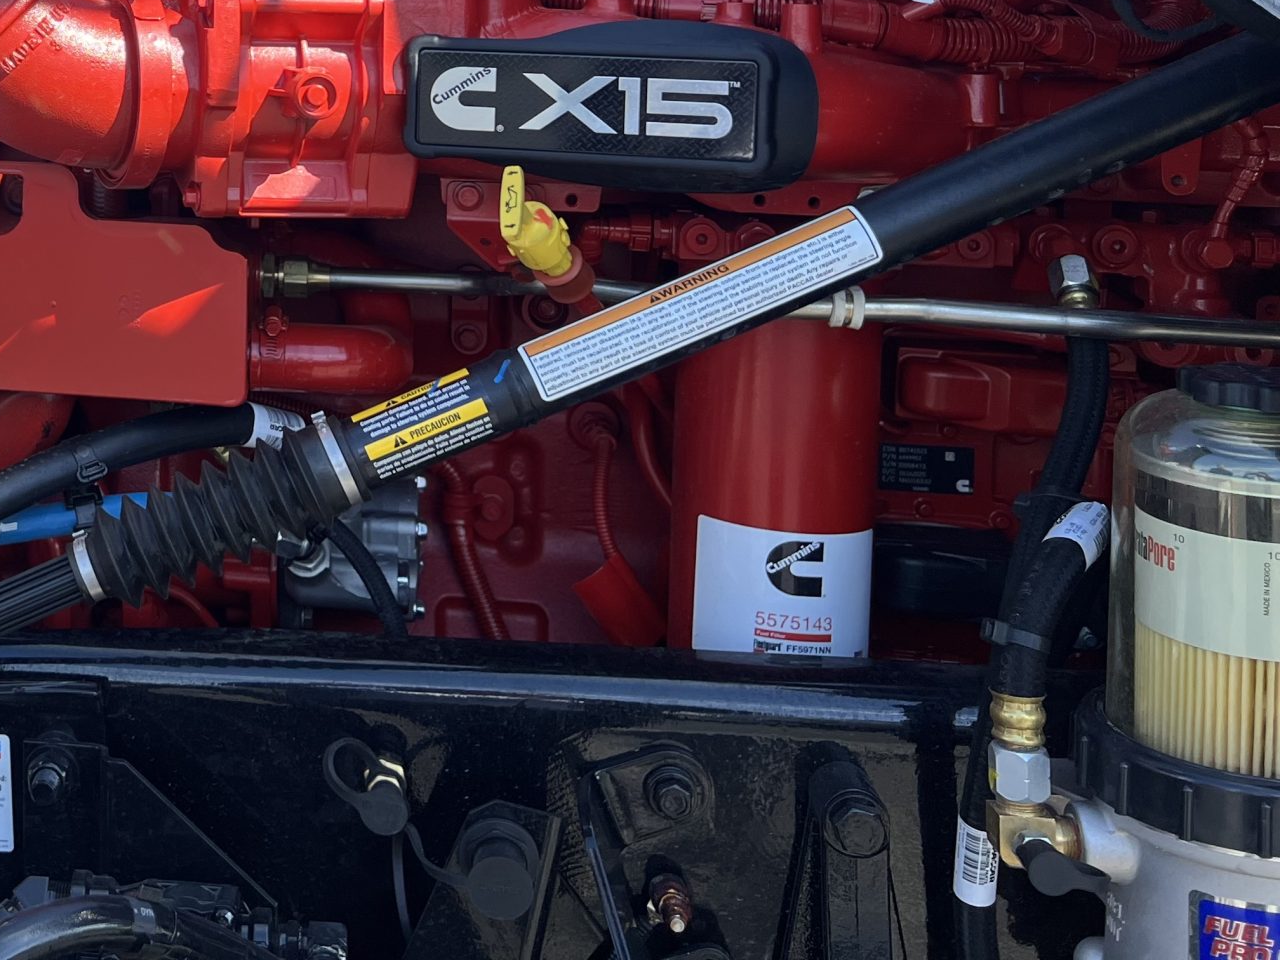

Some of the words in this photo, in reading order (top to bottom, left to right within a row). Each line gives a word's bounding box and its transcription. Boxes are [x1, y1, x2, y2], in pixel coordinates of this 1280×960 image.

[432, 66, 492, 106] Cummins
[519, 72, 732, 139] X15
[658, 263, 729, 299] WARNING
[408, 411, 461, 440] PRECAUCION
[1174, 533, 1185, 543] 10
[766, 541, 820, 574] Cummins
[754, 611, 832, 632] 5575143
[1204, 915, 1275, 947] FUEL
[1210, 938, 1271, 960] PRO
